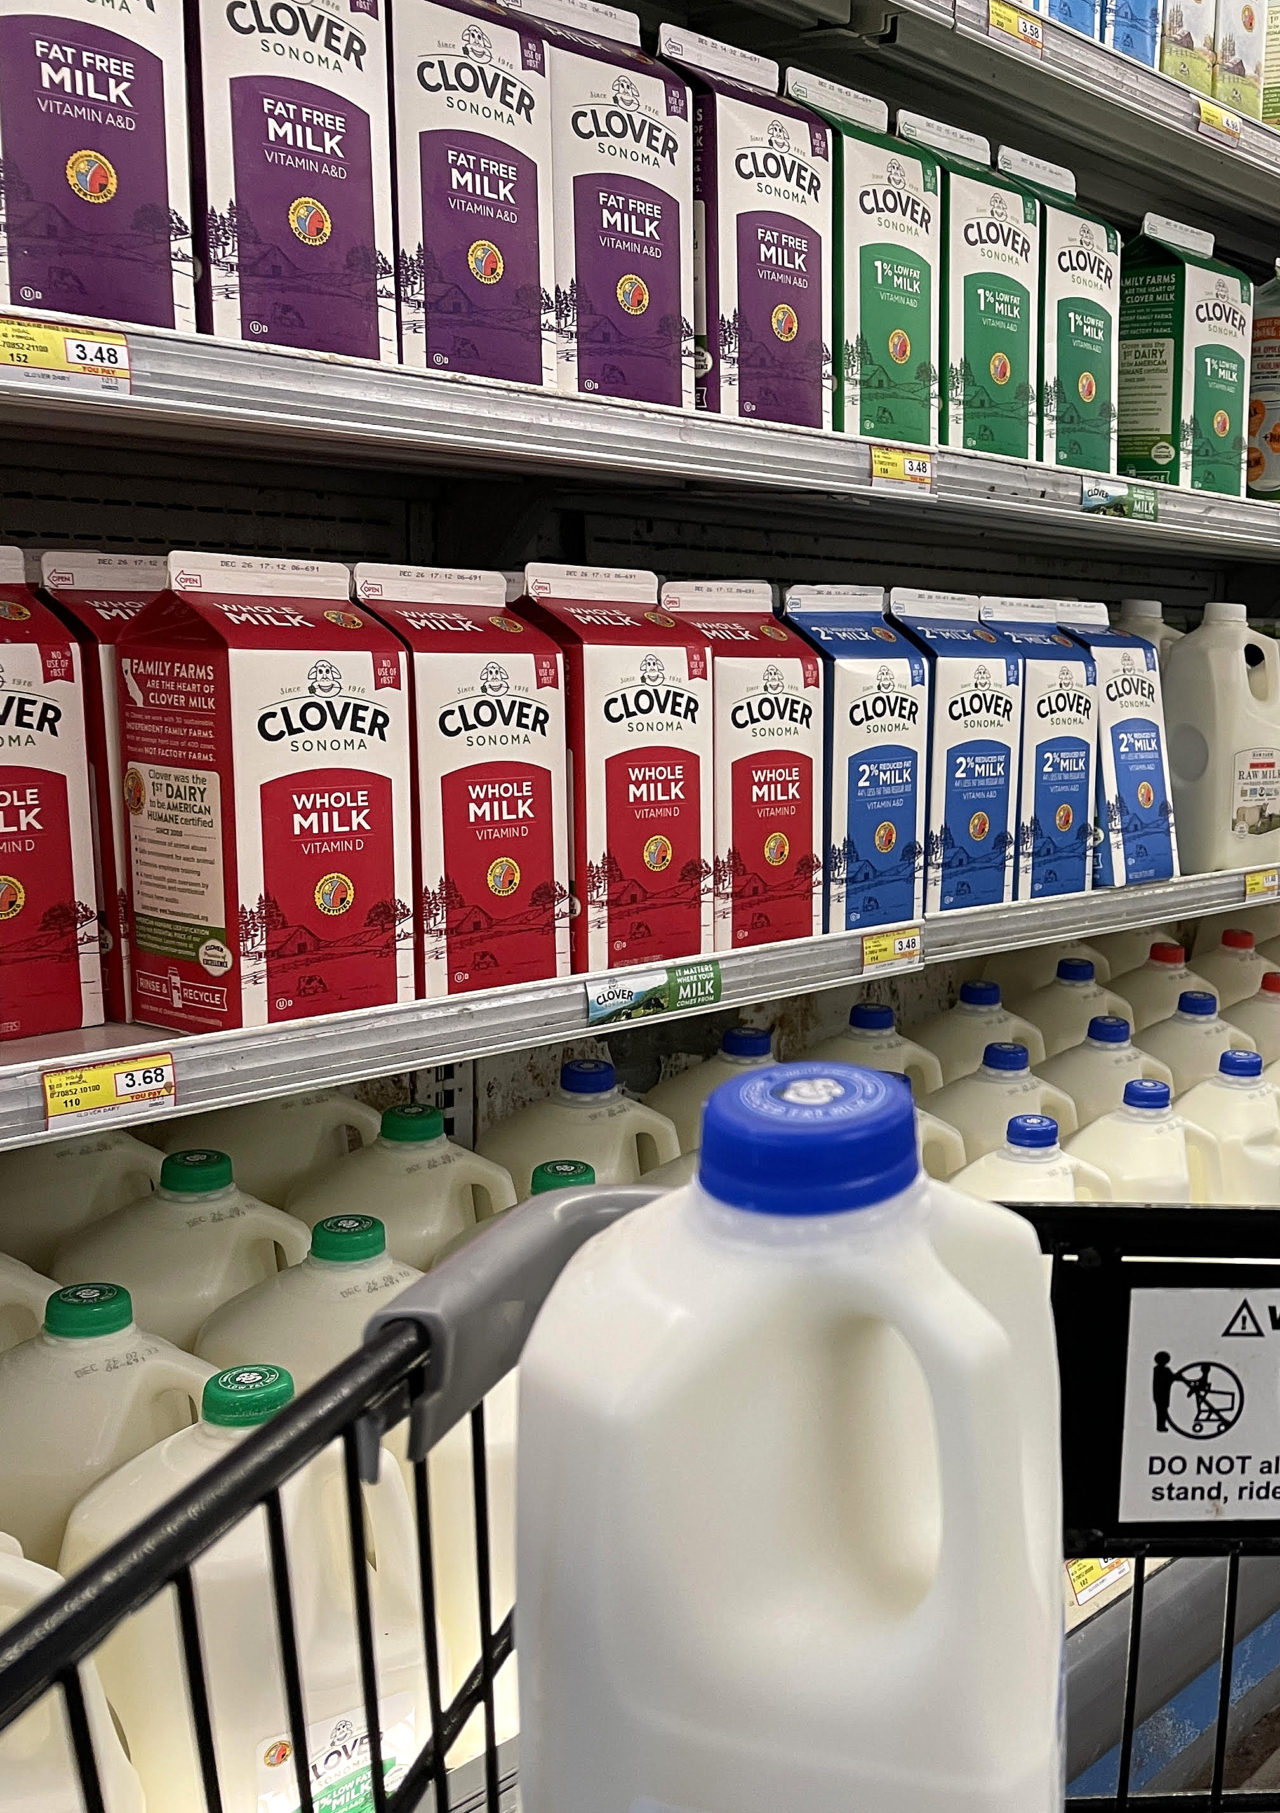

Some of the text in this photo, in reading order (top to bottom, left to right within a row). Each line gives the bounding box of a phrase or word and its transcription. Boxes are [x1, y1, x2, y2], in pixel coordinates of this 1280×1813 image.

[226, 0, 367, 72] CLOVER
[1022, 21, 1040, 39] 3.58
[35, 40, 135, 79] FAT FREE
[261, 39, 343, 74] SONOMA
[40, 62, 134, 108] MILK
[416, 60, 535, 124] CLOVER
[36, 97, 136, 131] VITAMIN A&D
[263, 97, 346, 133] FAT FREE
[446, 96, 515, 126] SONOMA
[267, 118, 344, 158] MILK
[571, 110, 678, 166] CLOVER
[264, 150, 347, 180] VITAMIN A&D
[447, 150, 517, 181] FAT FREE
[598, 142, 661, 168] SONOMA
[451, 167, 515, 204] MILK
[735, 153, 820, 203] CLOVER
[599, 192, 661, 219] FAT FREE
[757, 183, 808, 205] SONOMA
[448, 198, 518, 224] VITAMIN A&D
[859, 189, 931, 234] CLOVER
[602, 208, 660, 241] MILK
[758, 228, 808, 252] FAT FREE
[964, 221, 1031, 263] CLOVER
[760, 243, 807, 272] MILK
[874, 260, 892, 285] 1%
[1057, 250, 1112, 290] CLOVER
[894, 276, 921, 294] MILK
[995, 302, 1020, 319] MILK
[1196, 302, 1246, 336] CLOVER
[9, 353, 28, 363] 152
[75, 344, 118, 364] 3.48
[909, 461, 927, 473] 3.48
[220, 560, 236, 568] DEC
[52, 574, 71, 583] OPEN
[180, 576, 199, 586] OPEN
[133, 659, 214, 680] FAMILY FARMS
[377, 668, 396, 676] USE OF
[382, 660, 391, 668] NO
[146, 679, 214, 693] ARE THE HEART OF
[280, 685, 301, 695] Since
[1106, 678, 1155, 702] CLOVER
[149, 692, 215, 709] CLOVER MILK
[603, 690, 699, 724] CLOVER
[849, 691, 919, 726] CLOVER
[949, 692, 1013, 722] CLOVER
[1037, 692, 1092, 720] CLOVER
[257, 701, 390, 742] CLOVER
[438, 700, 550, 737] CLOVER
[731, 697, 812, 730] CLOVER
[165, 726, 187, 736] FAMILY
[628, 721, 683, 733] SONOMA
[291, 740, 367, 752] SONOMA
[466, 735, 531, 746] SONOMA
[149, 769, 206, 785] Clover was the
[629, 766, 683, 782] WHOLE
[752, 767, 799, 782] WHOLE
[858, 764, 879, 787] 2%
[1238, 770, 1258, 781] RAW
[166, 783, 206, 802] DAIRY
[292, 791, 368, 810] WHOLE
[468, 781, 532, 800] WHOLE
[628, 781, 685, 802] MILK
[752, 781, 800, 802] MILK
[147, 810, 213, 828] HUMANE certified
[157, 800, 165, 809] be
[167, 802, 211, 815] AMERICAN
[468, 799, 534, 823] MILK
[293, 809, 371, 835] MILK
[898, 938, 916, 951] 3.48
[677, 973, 714, 984] WHERE YOUR
[683, 965, 712, 976] MATTERS
[140, 978, 220, 1004] RINSE & RECYCLE
[596, 989, 634, 1006] CLOVER
[678, 982, 714, 999] MILK
[125, 1068, 164, 1088] 3.68
[64, 1098, 80, 1108] 110
[74, 1363, 98, 1379] DEC
[1149, 1456, 1187, 1475] DO
[1196, 1455, 1252, 1475] NOT
[1151, 1481, 1228, 1504] stand,
[318, 1757, 369, 1786] SONOMA
[332, 1780, 372, 1810] MILK
[333, 1771, 372, 1796] LOW FAT
